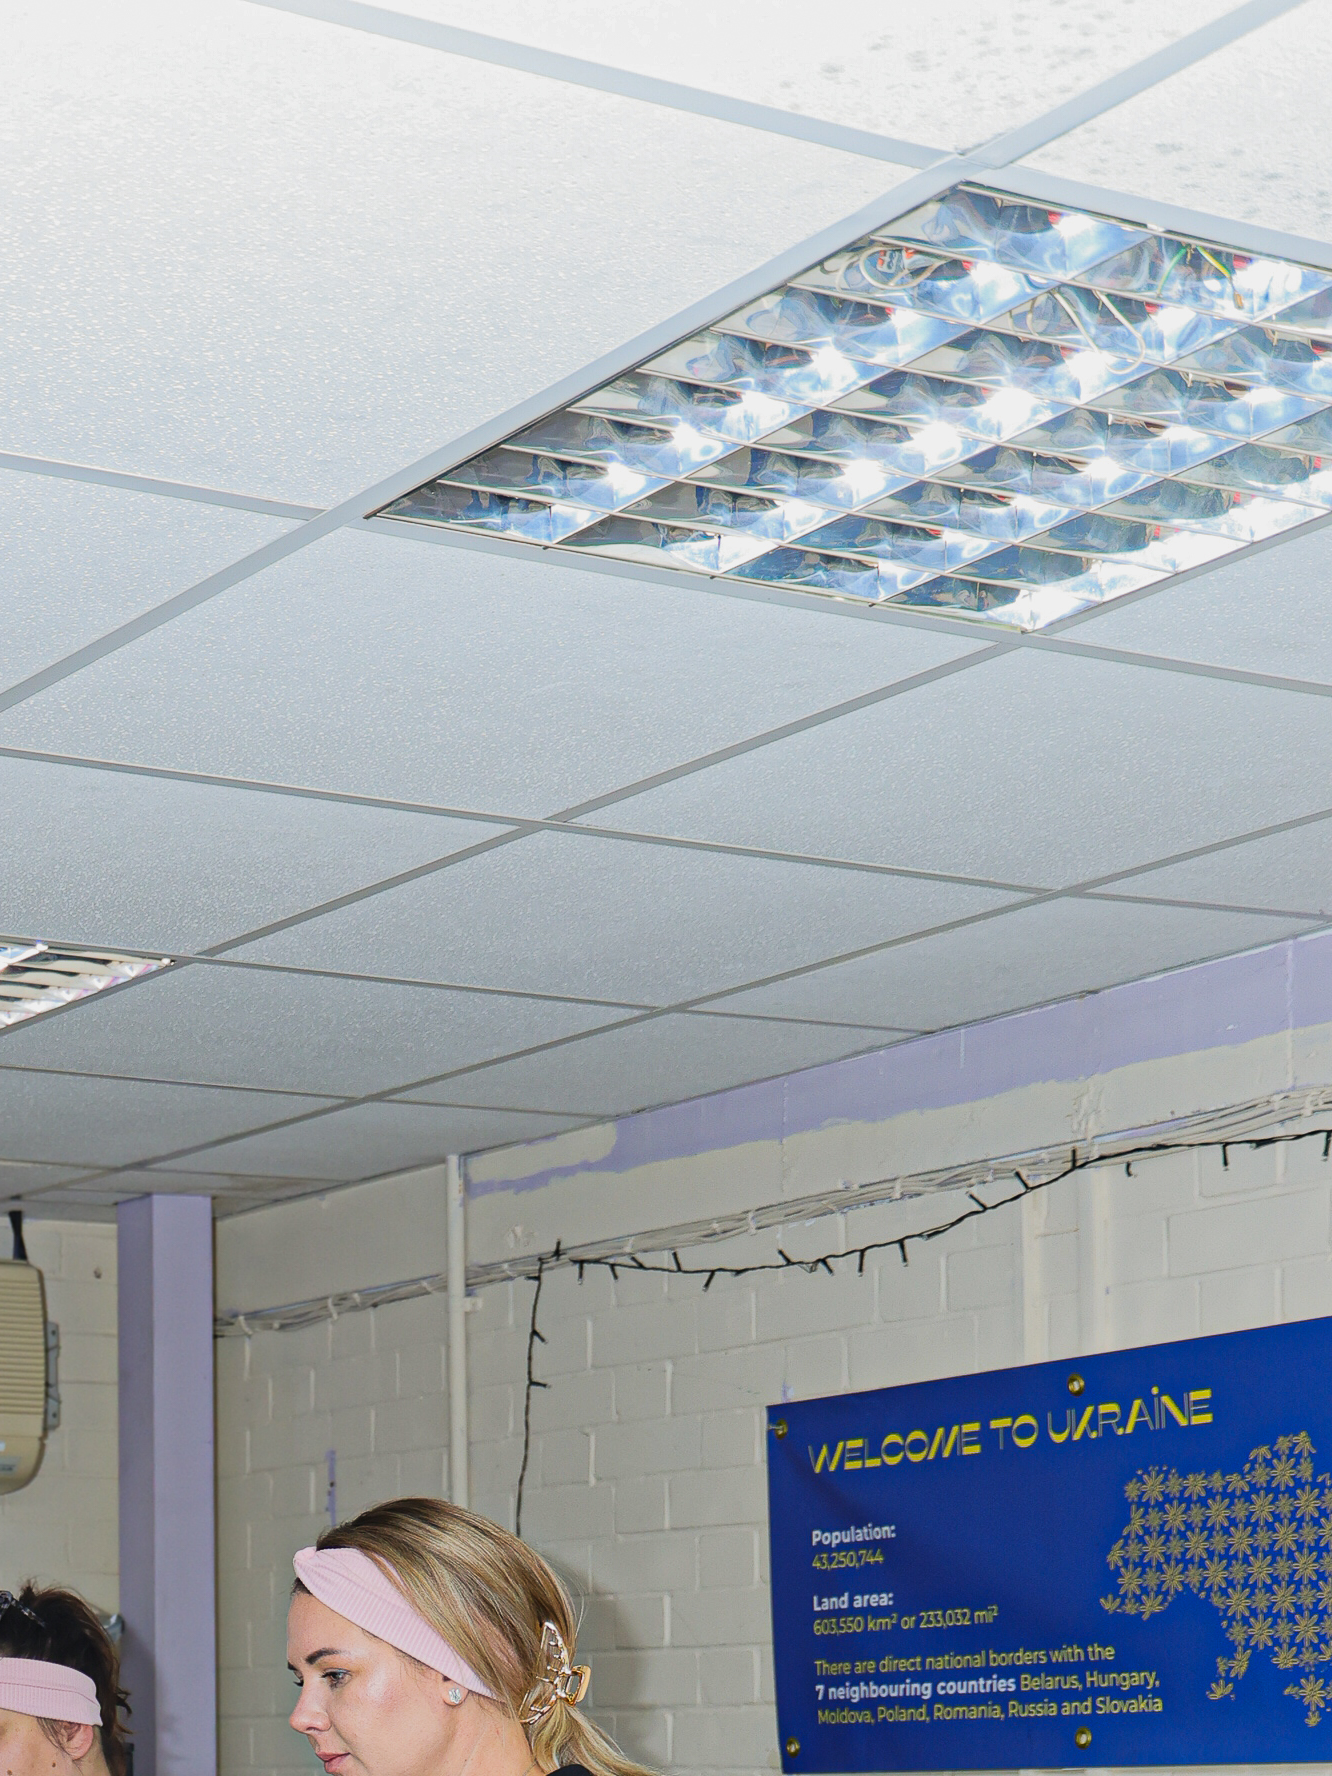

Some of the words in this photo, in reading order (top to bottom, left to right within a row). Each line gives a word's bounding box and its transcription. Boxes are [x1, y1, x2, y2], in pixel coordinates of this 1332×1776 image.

[808, 1422, 981, 1474] WELCOME
[989, 1413, 1039, 1450] TO
[1047, 1386, 1213, 1444] UKRAINE
[811, 1523, 897, 1547] Population:
[812, 1548, 884, 1571] 43,250,744
[813, 1592, 849, 1611] Land
[853, 1592, 894, 1608] area:
[813, 1616, 864, 1636] 603,550
[900, 1614, 916, 1630] or
[919, 1608, 971, 1629] 233,032
[814, 1659, 851, 1676] There
[854, 1661, 876, 1674] are
[879, 1655, 922, 1672] direct
[925, 1650, 986, 1670] national
[989, 1646, 1047, 1667] borders
[1049, 1643, 1084, 1663] with
[1087, 1642, 1115, 1661] the
[815, 1684, 825, 1700] 7
[828, 1678, 932, 1703] neighbouring
[936, 1674, 1016, 1695] countries
[1020, 1672, 1083, 1691] Belarus,
[1085, 1670, 1160, 1690] Hungary,
[818, 1707, 875, 1726] Moldova,
[877, 1703, 930, 1723] Poland,
[933, 1701, 1005, 1721] Romania,
[1008, 1698, 1058, 1718] Russia
[1061, 1696, 1092, 1716] and
[1095, 1693, 1163, 1714] Slovakia
